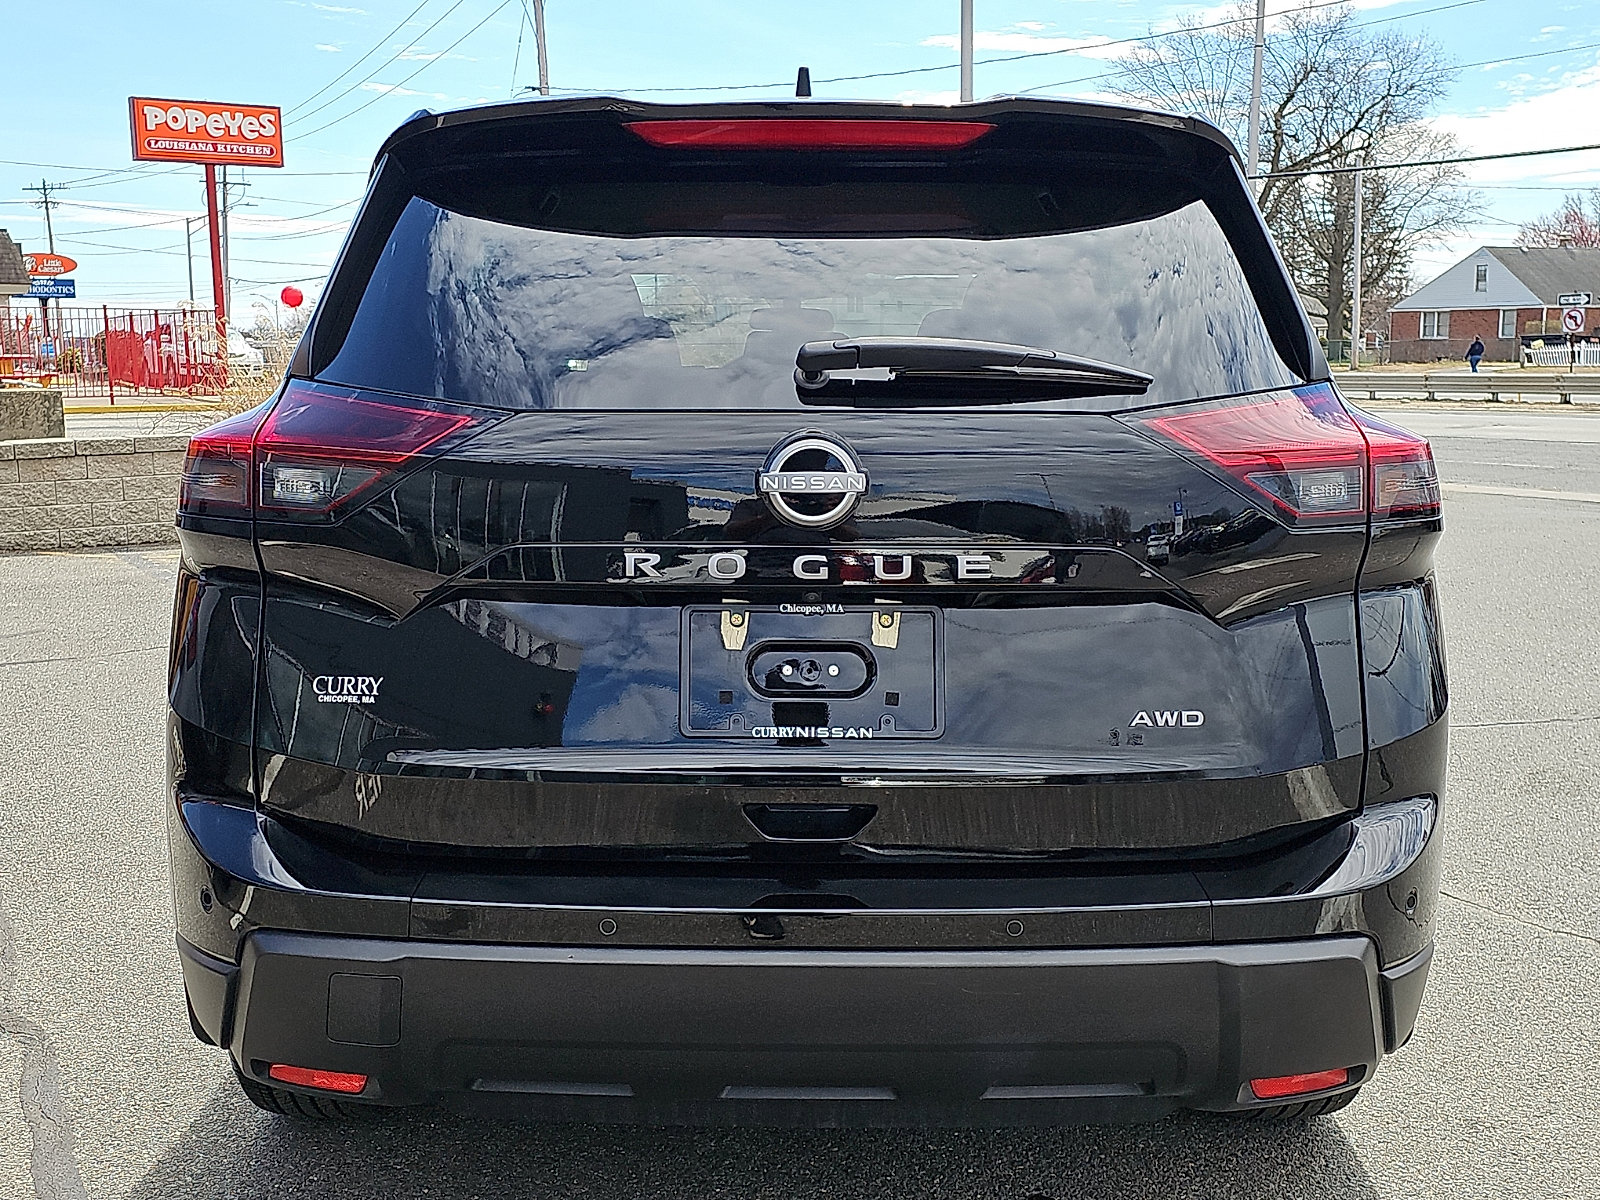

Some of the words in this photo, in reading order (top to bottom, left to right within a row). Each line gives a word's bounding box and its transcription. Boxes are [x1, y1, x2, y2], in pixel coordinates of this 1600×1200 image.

[150, 139, 215, 152] LOUISIANA
[216, 142, 271, 155] KITCHEN
[28, 285, 75, 294] HODONTICS
[762, 476, 863, 490] NISSAN
[624, 552, 992, 580] ROGUE
[826, 603, 845, 613] MA
[312, 675, 384, 696] CURRY
[318, 695, 361, 704] CHICOPEE,
[361, 695, 376, 704] MA
[1129, 710, 1205, 727] AWD
